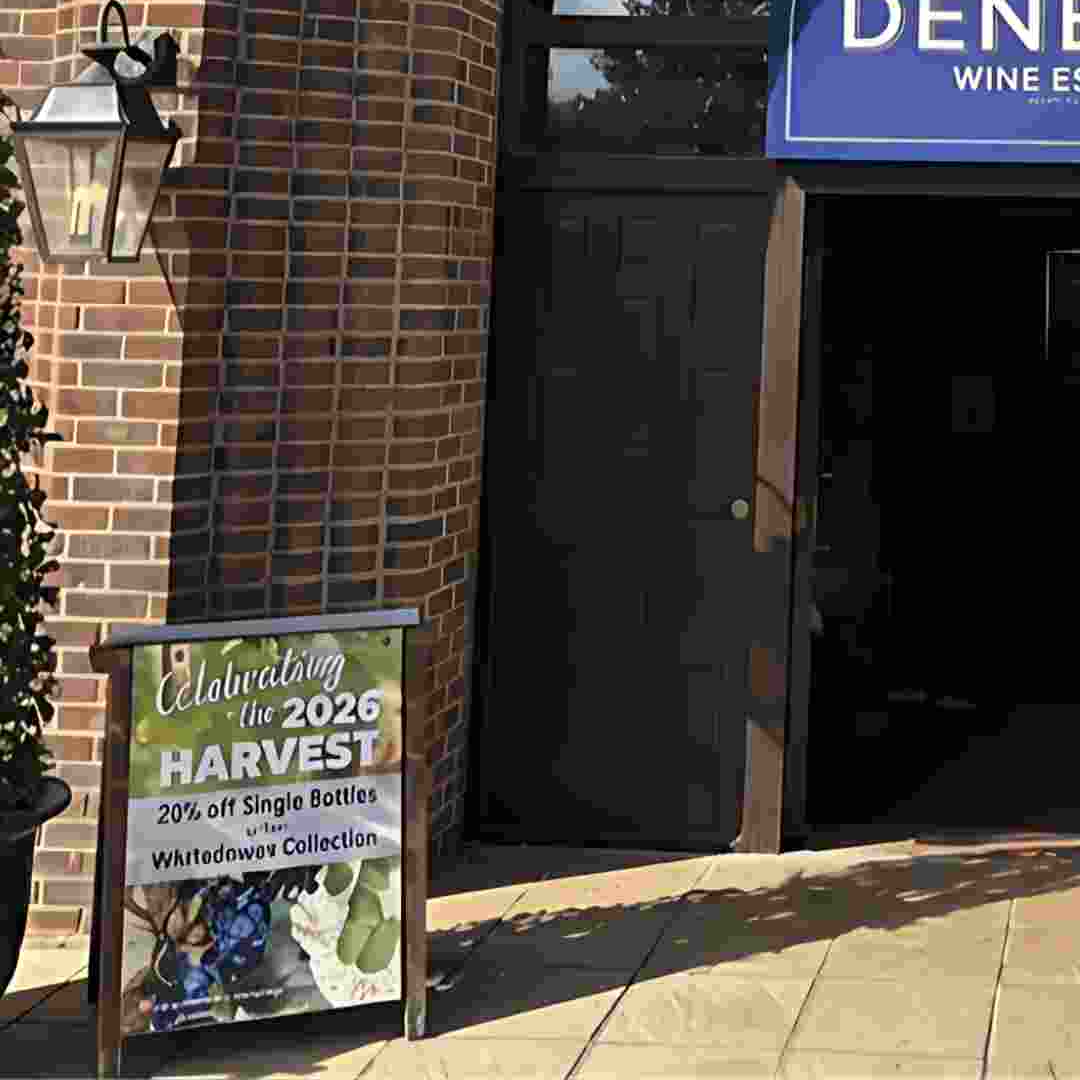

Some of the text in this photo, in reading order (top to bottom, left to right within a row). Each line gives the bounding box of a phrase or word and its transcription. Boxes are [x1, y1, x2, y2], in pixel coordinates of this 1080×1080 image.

[953, 65, 1040, 93] WINE
[282, 687, 384, 729] 2026
[160, 729, 380, 788] HARVEST
[157, 784, 378, 824] 20% off Single Bottles
[283, 827, 378, 856] Collection
